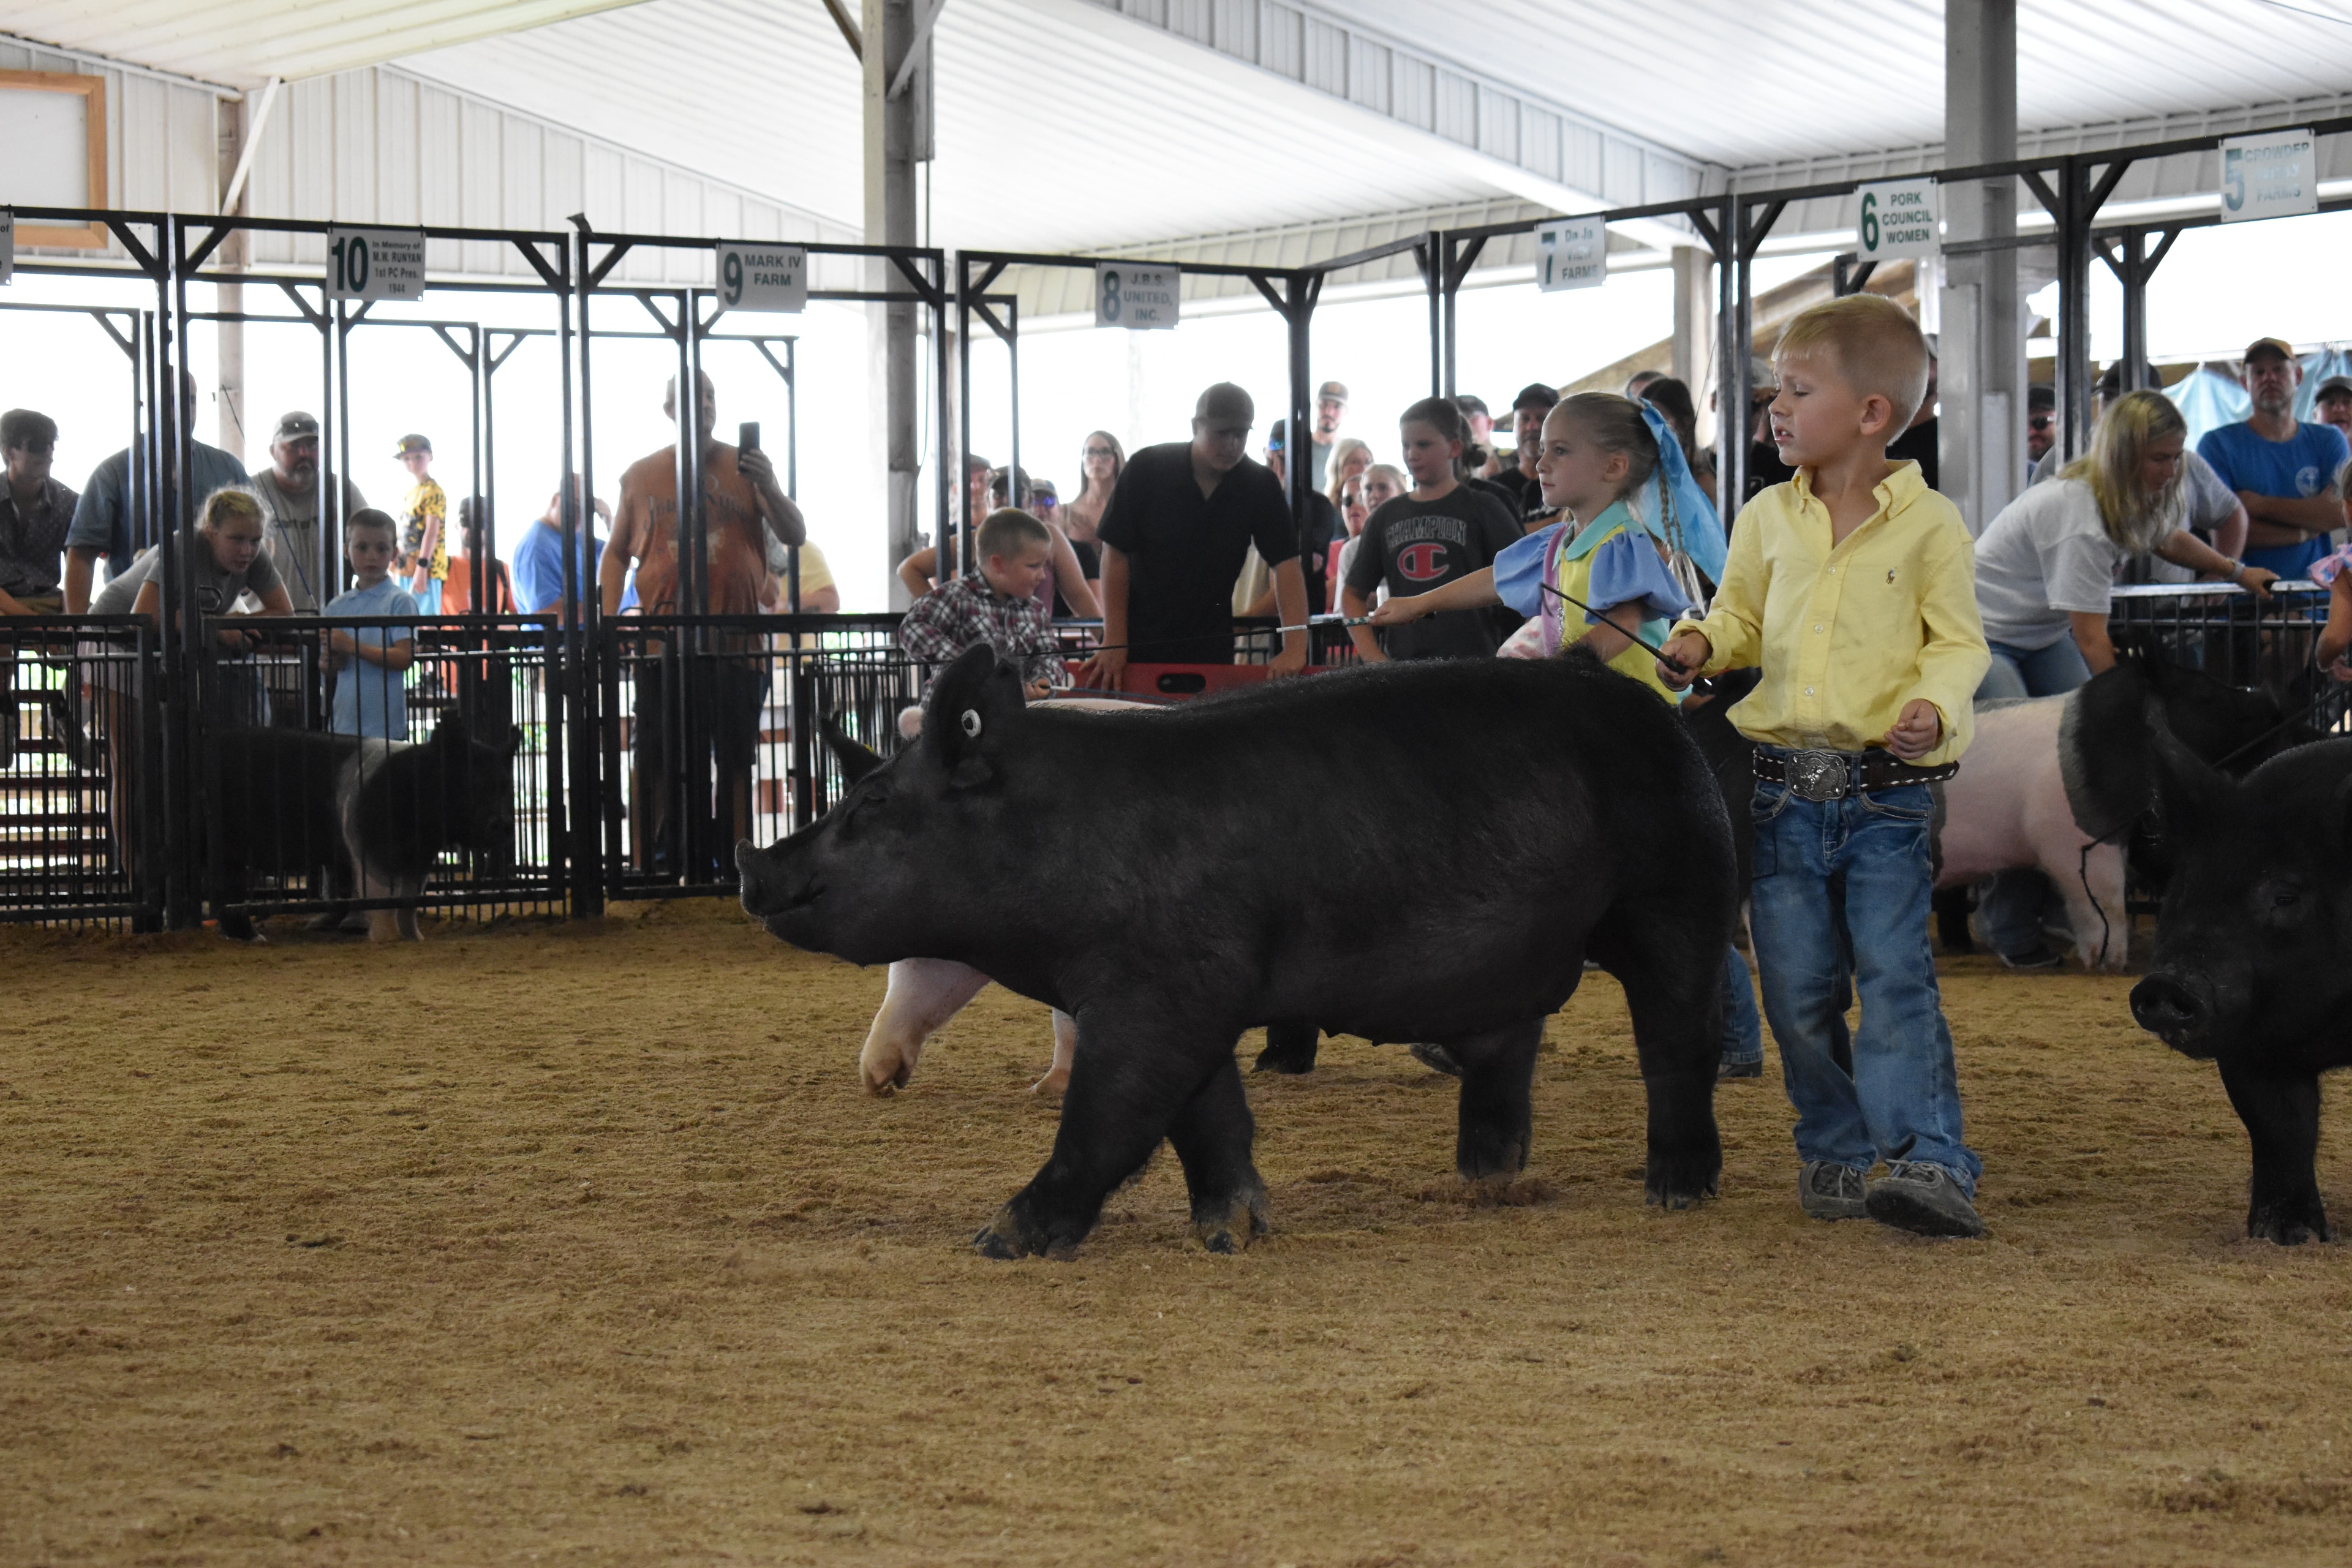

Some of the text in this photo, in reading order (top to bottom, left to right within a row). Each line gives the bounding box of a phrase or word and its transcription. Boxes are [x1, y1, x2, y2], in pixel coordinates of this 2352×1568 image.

[2225, 148, 2244, 211] 5
[1891, 192, 1922, 206] PORK
[1861, 192, 1879, 252] 6
[1882, 210, 1932, 225] COUNCIL
[1887, 229, 1929, 244] WOMEN
[382, 241, 411, 250] Memory
[331, 236, 368, 292] 10
[392, 252, 421, 262] RUNYAN
[744, 254, 801, 268] MARK IV
[375, 267, 419, 278] 1st PC Pres.
[724, 252, 743, 306] 9
[754, 273, 791, 286] FARM
[1562, 265, 1597, 280] FARMS
[1103, 271, 1121, 322] 8
[1124, 290, 1172, 305] UNITED,
[1135, 309, 1160, 321] INC.
[1385, 515, 1466, 553] CHAMPION
